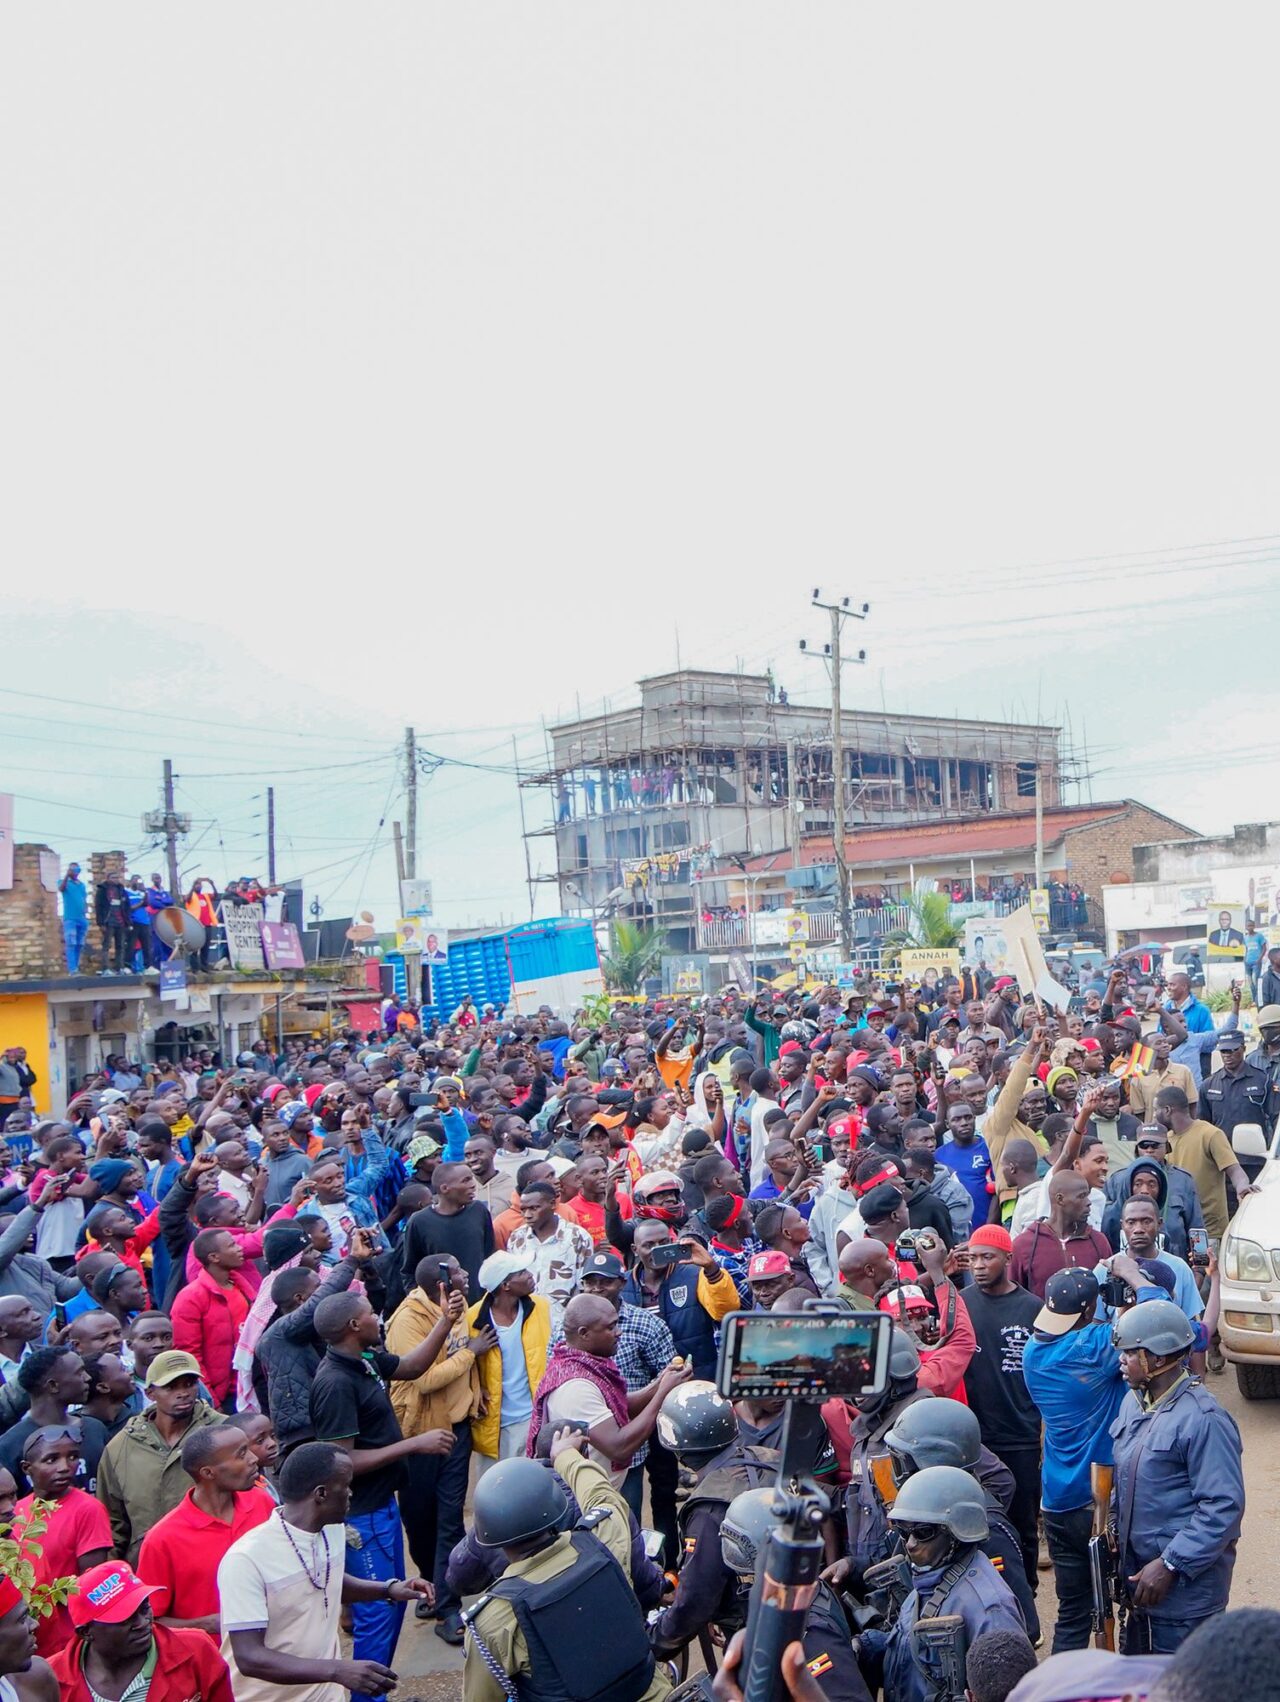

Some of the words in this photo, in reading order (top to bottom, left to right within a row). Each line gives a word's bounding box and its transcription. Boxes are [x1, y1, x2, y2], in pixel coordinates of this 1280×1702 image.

[227, 919, 260, 933] SHOPPIN
[235, 934, 262, 949] CENTRE
[911, 951, 949, 960] ANNAH
[87, 1573, 120, 1605] NUP
